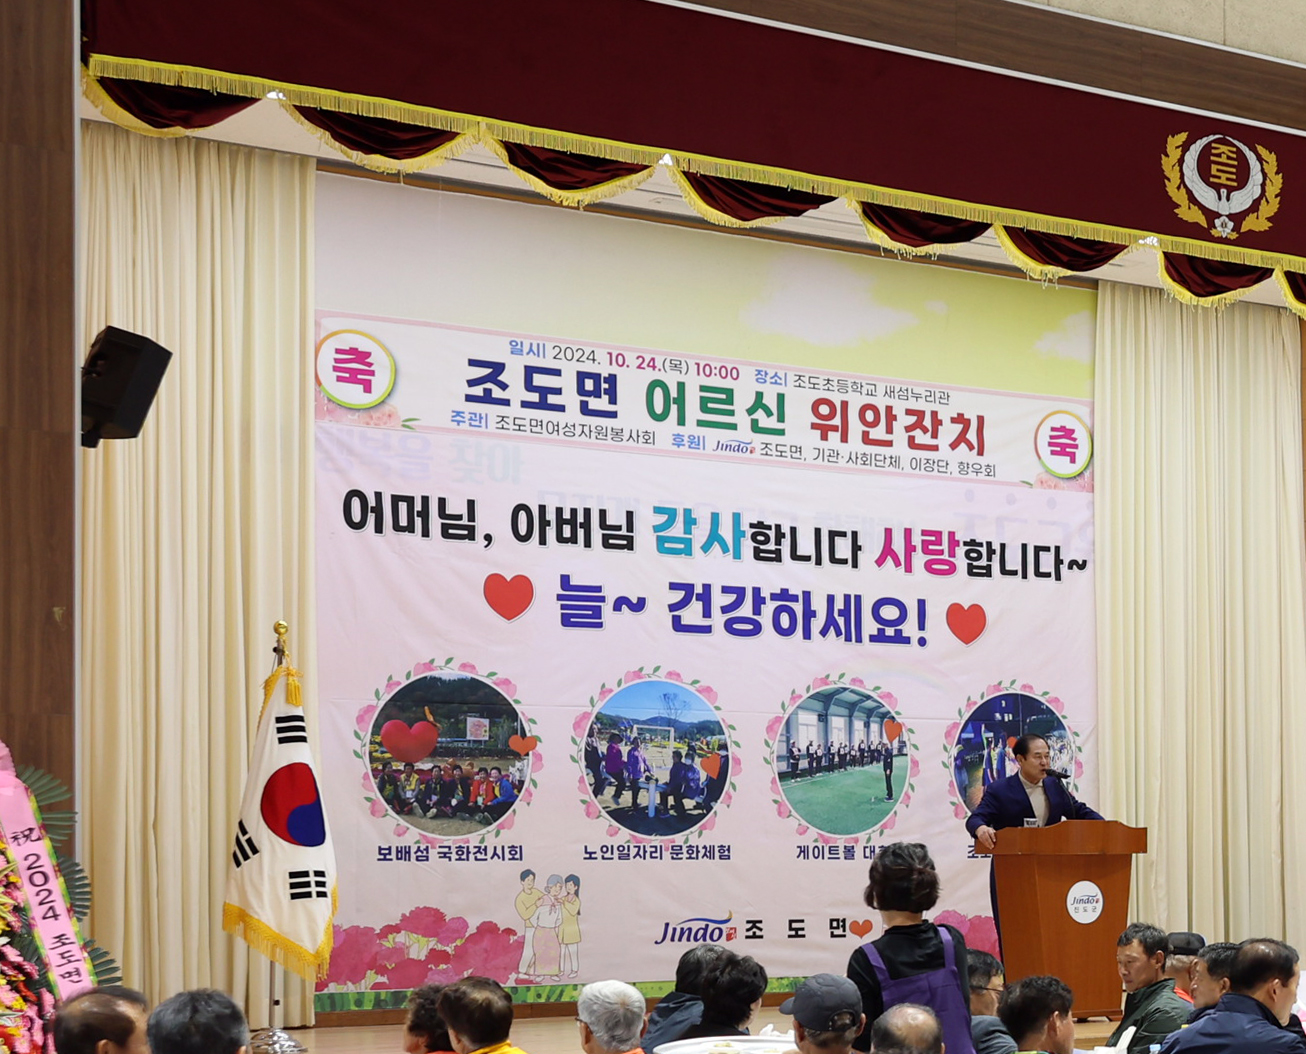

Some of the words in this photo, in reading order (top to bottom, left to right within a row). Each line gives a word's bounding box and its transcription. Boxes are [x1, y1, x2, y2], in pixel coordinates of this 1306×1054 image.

[1209, 142, 1238, 187] 조도
[332, 346, 376, 395] 축
[552, 345, 601, 366] 2024.
[606, 351, 630, 369] 10.
[636, 354, 690, 376] 24.(목)
[694, 362, 741, 381] 10:00
[793, 374, 878, 398] 조도초등학교
[882, 384, 951, 406] 새섬누리관
[464, 357, 619, 420] 조도면
[645, 378, 786, 437] 어르신
[810, 397, 986, 457] 위안잔치
[495, 414, 657, 446] 조도면여성자원봉사회
[759, 442, 807, 463] 조도면,
[909, 457, 953, 477] 이장단,
[957, 461, 997, 479] 향우회
[1047, 425, 1080, 465] 축
[342, 488, 494, 549] 어머님,
[510, 502, 636, 552] 아버님
[652, 504, 863, 570] 감사합니다
[874, 526, 1088, 582] 사랑합니다~
[555, 573, 648, 631] 늘~
[667, 580, 929, 648] 건강하세요!
[9, 827, 43, 847] 祝
[376, 845, 430, 862] 보배섬
[436, 844, 524, 862] 국화전시회
[582, 844, 665, 861] 노인일자리
[669, 844, 732, 861] 문화체험
[796, 845, 856, 860] 게이트볼
[863, 845, 888, 860] 대
[23, 853, 62, 921] 2024
[1071, 896, 1095, 905] Jindo
[654, 920, 724, 945] Jindo
[48, 932, 83, 984] 조도면
